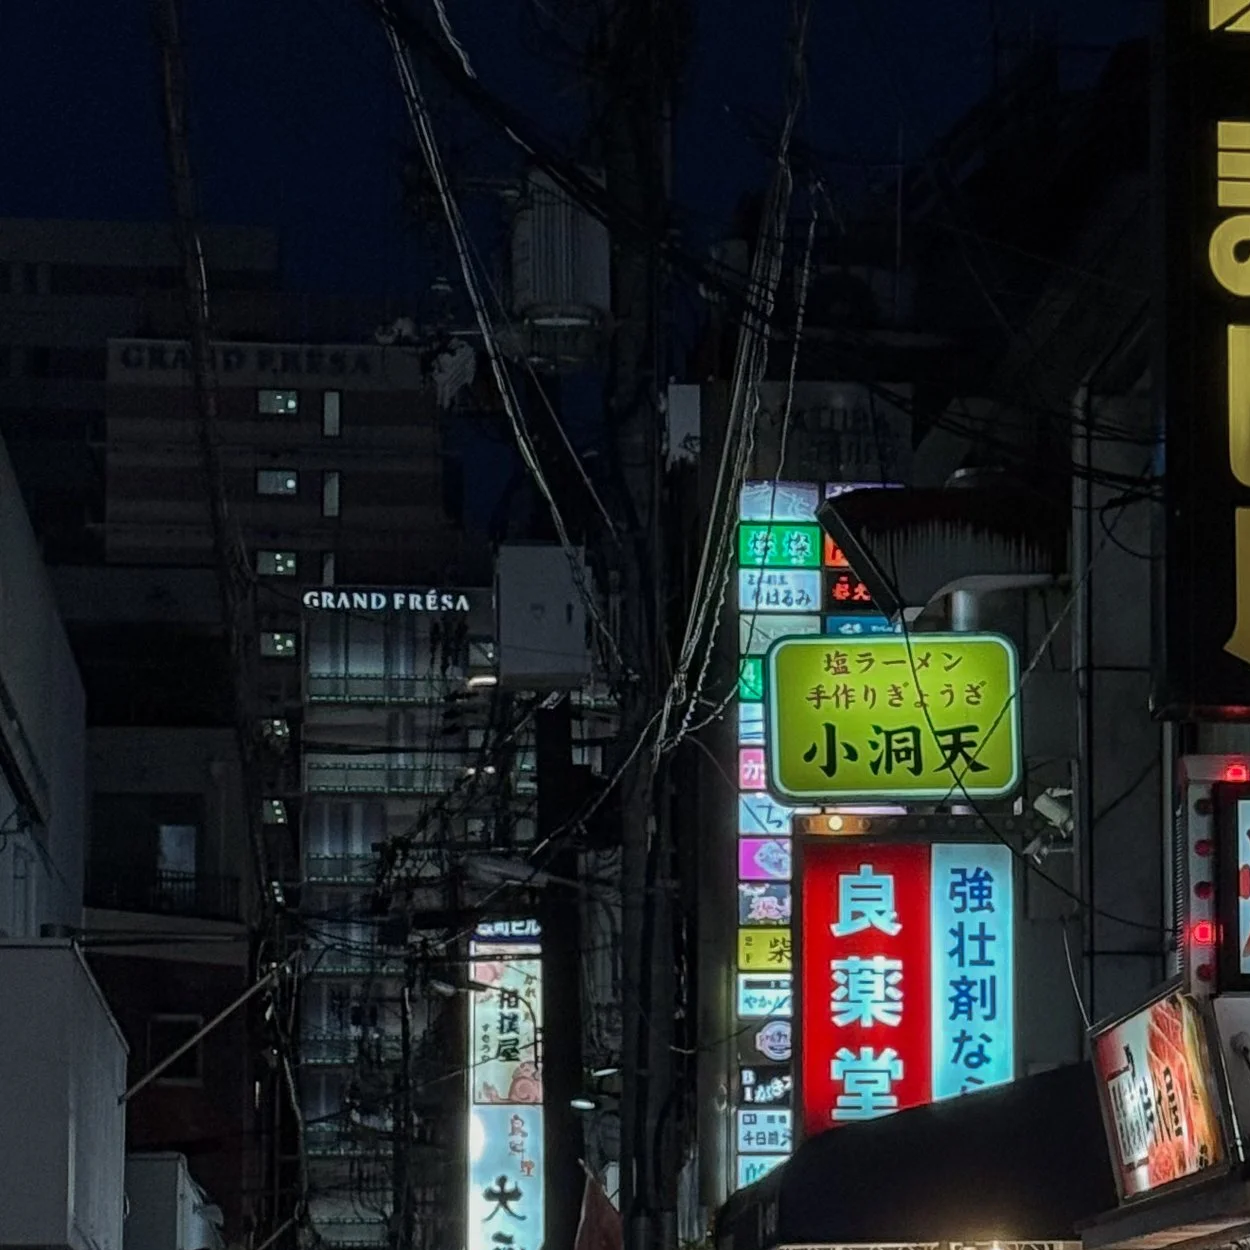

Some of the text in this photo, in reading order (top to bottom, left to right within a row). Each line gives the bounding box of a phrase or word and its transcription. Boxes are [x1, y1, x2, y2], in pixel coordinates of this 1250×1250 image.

[302, 588, 470, 611] GRAND FRÉSA
[824, 649, 964, 676] 塩ラーメン
[805, 680, 987, 710] 手作りぎょうざ
[802, 721, 990, 779] 小洞天
[829, 863, 904, 1123] 良薬堂
